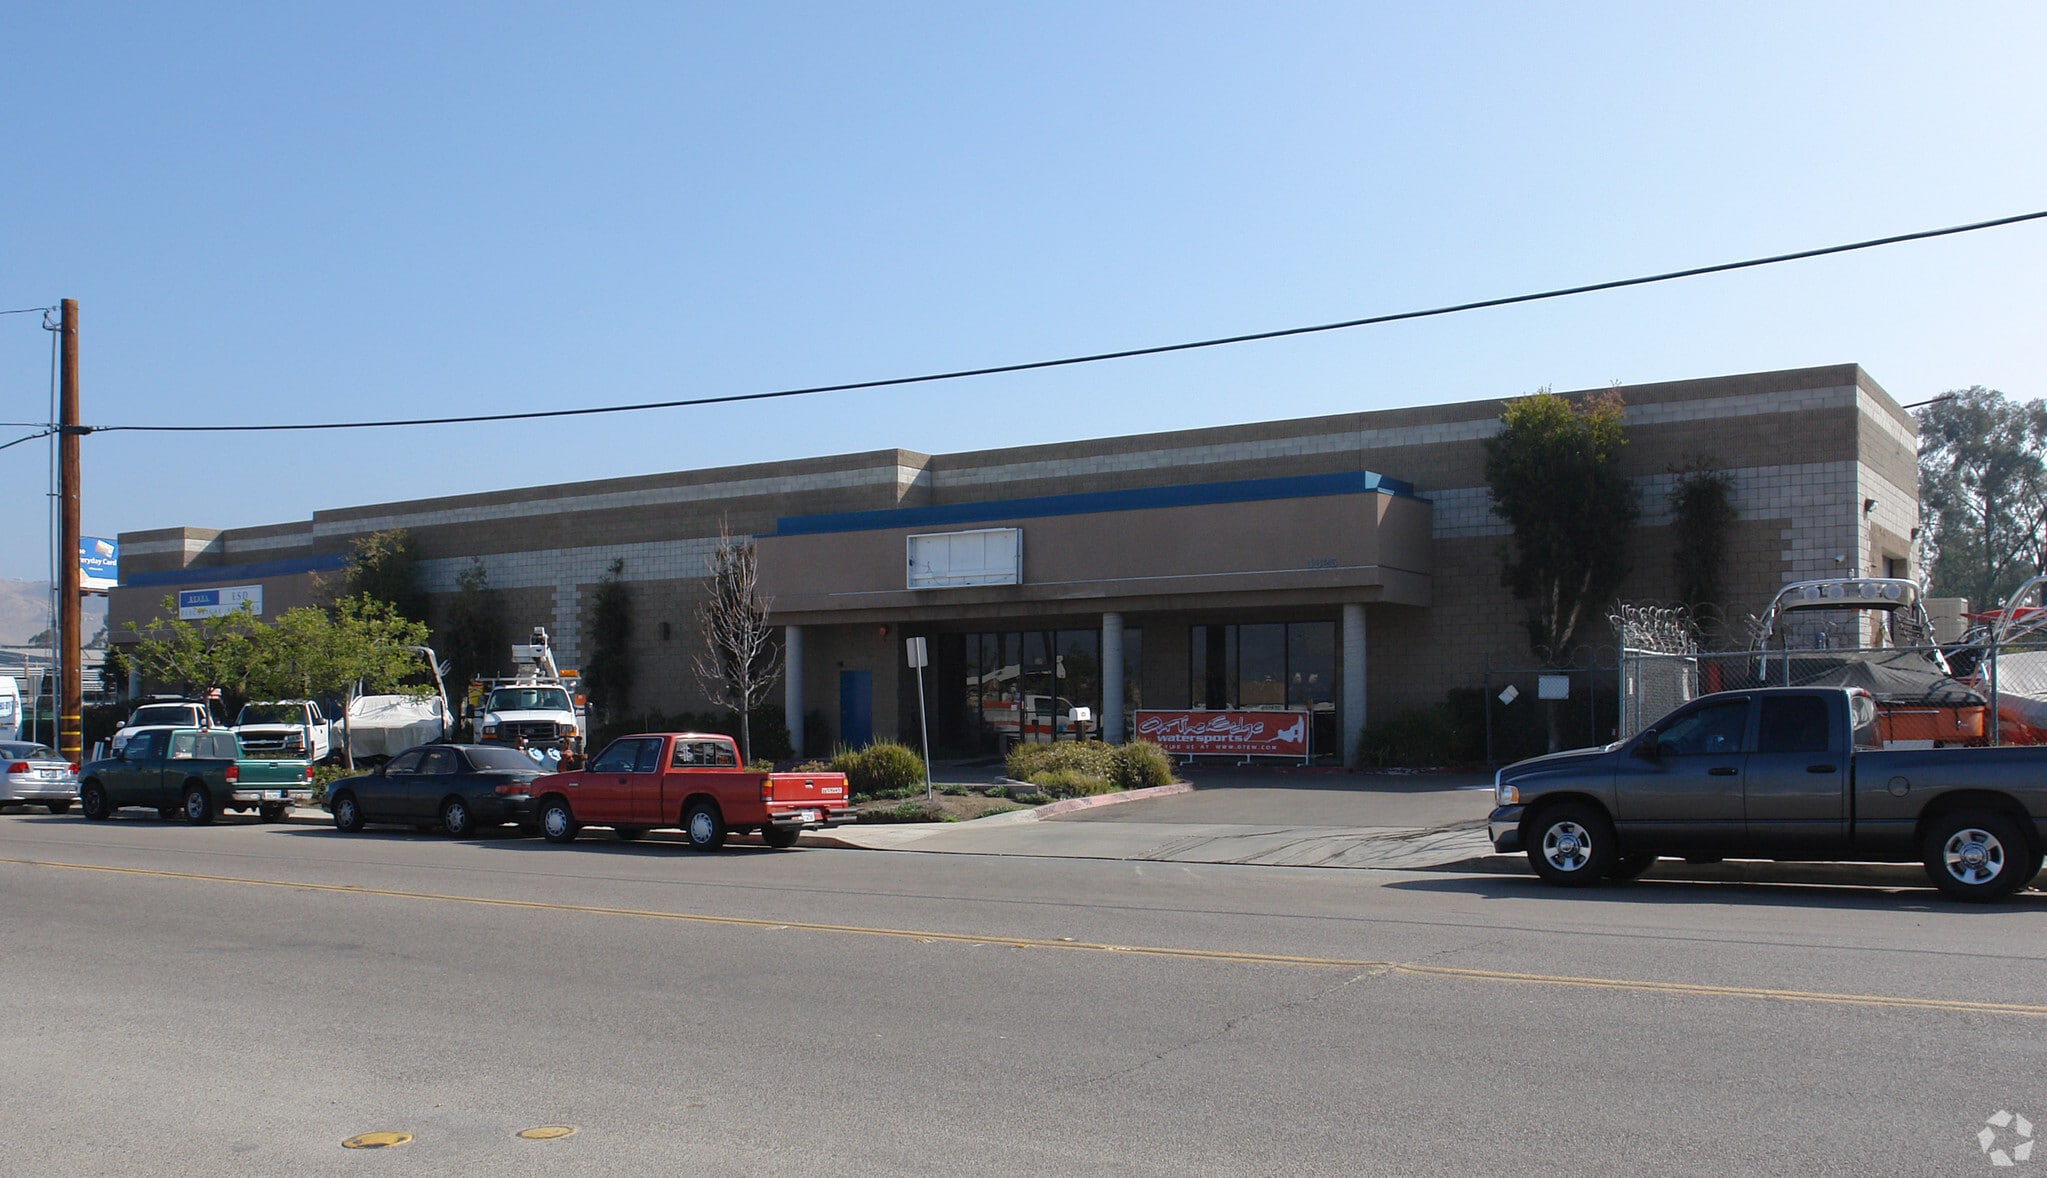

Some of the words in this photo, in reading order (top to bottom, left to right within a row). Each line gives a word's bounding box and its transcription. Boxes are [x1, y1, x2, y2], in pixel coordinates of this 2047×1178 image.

[80, 557, 102, 566] veryday
[1138, 714, 1171, 734] On
[1168, 714, 1207, 735] The
[1206, 714, 1265, 742] Edge
[1156, 733, 1244, 744] watersports
